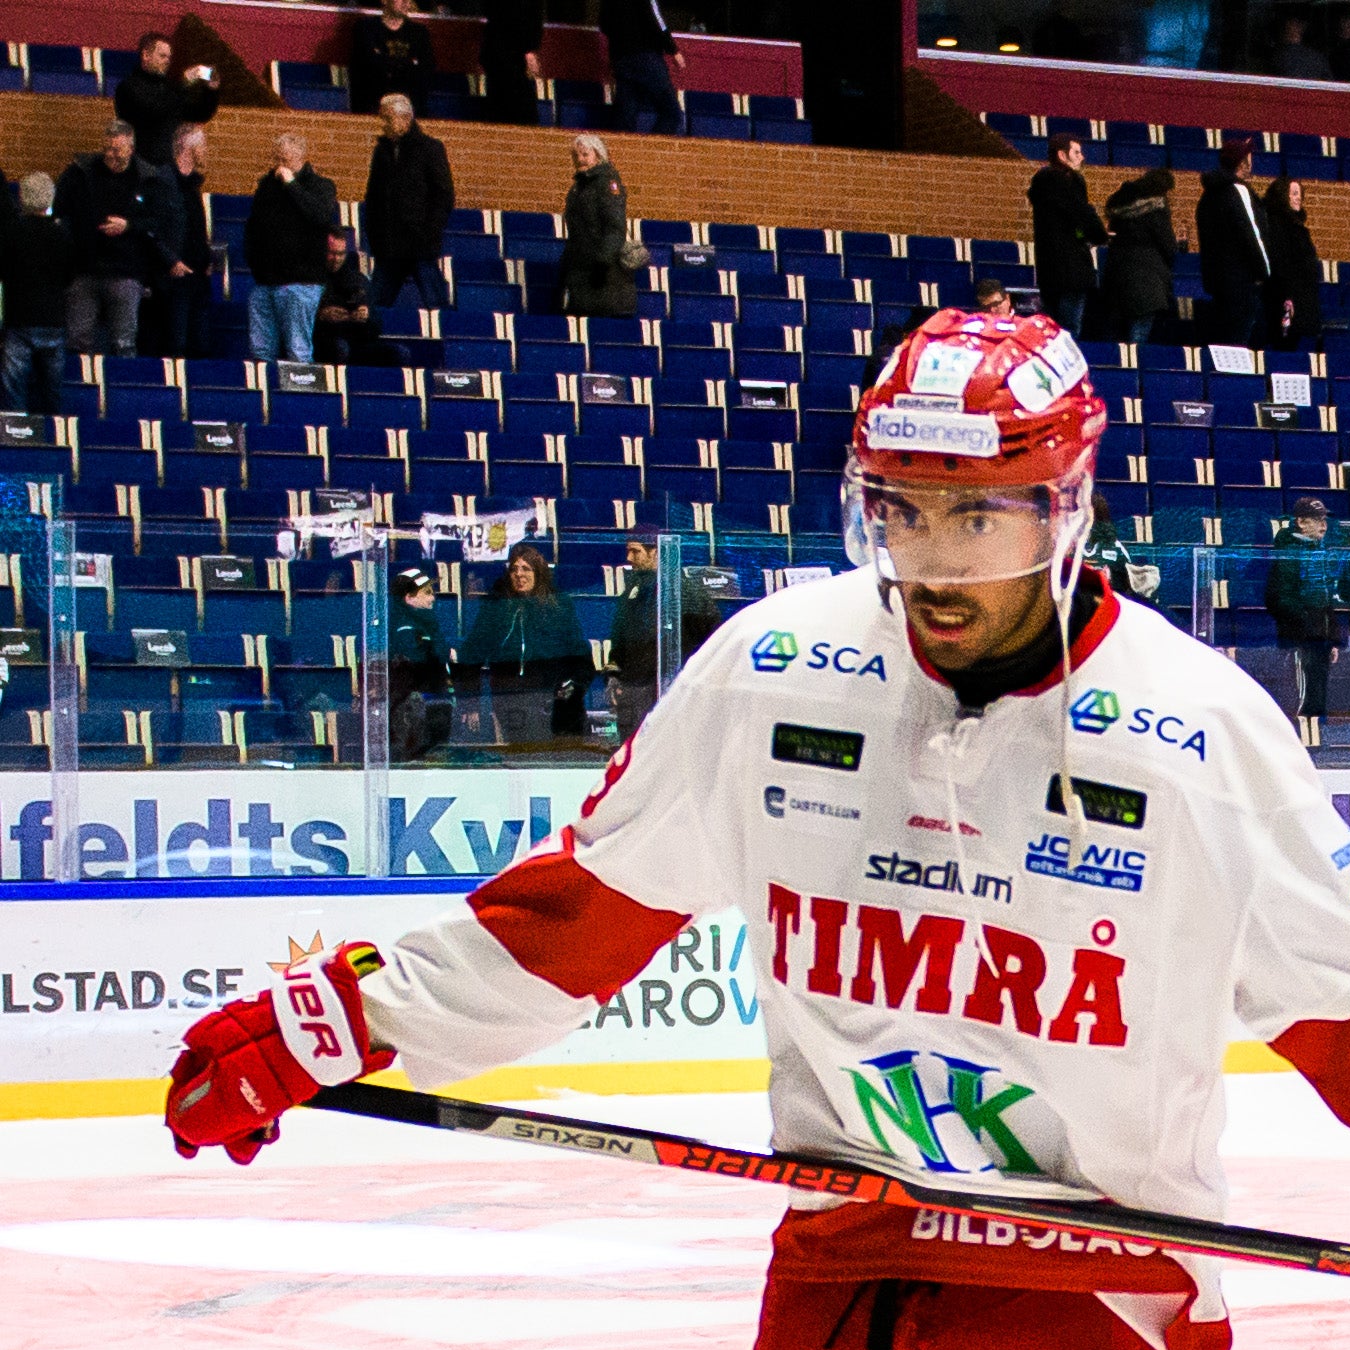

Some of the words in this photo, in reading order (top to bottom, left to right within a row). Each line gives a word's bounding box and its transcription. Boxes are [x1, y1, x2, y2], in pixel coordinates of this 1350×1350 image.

[807, 642, 886, 682] SCA
[1128, 708, 1205, 762] SCA
[767, 881, 1130, 1049] TIMRÅ
[513, 1122, 634, 1155] NEXUS
